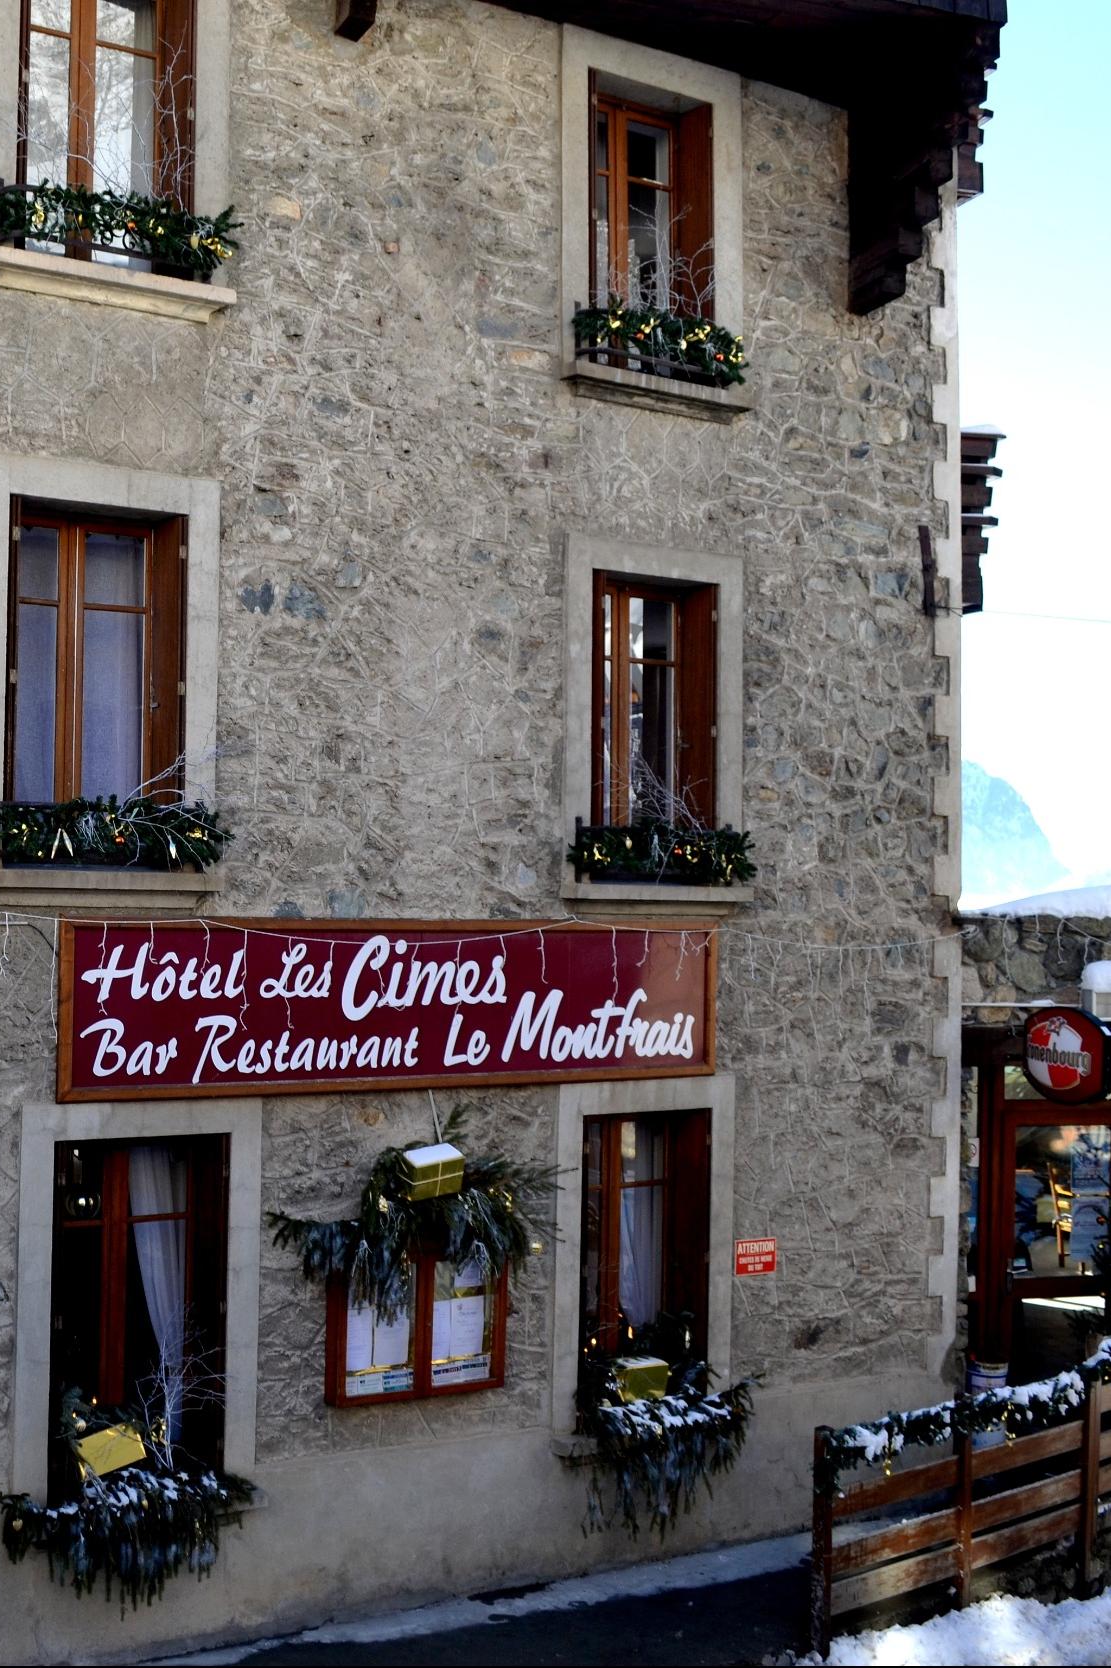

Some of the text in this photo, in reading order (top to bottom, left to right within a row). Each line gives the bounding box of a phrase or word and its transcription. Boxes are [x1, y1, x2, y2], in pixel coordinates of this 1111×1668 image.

[81, 935, 508, 1021] Hôtel Les Cimes
[80, 1017, 178, 1077] Bar
[192, 1014, 419, 1084] Restaurant
[444, 1014, 491, 1067] Le
[738, 1241, 775, 1255] ATTENTION
